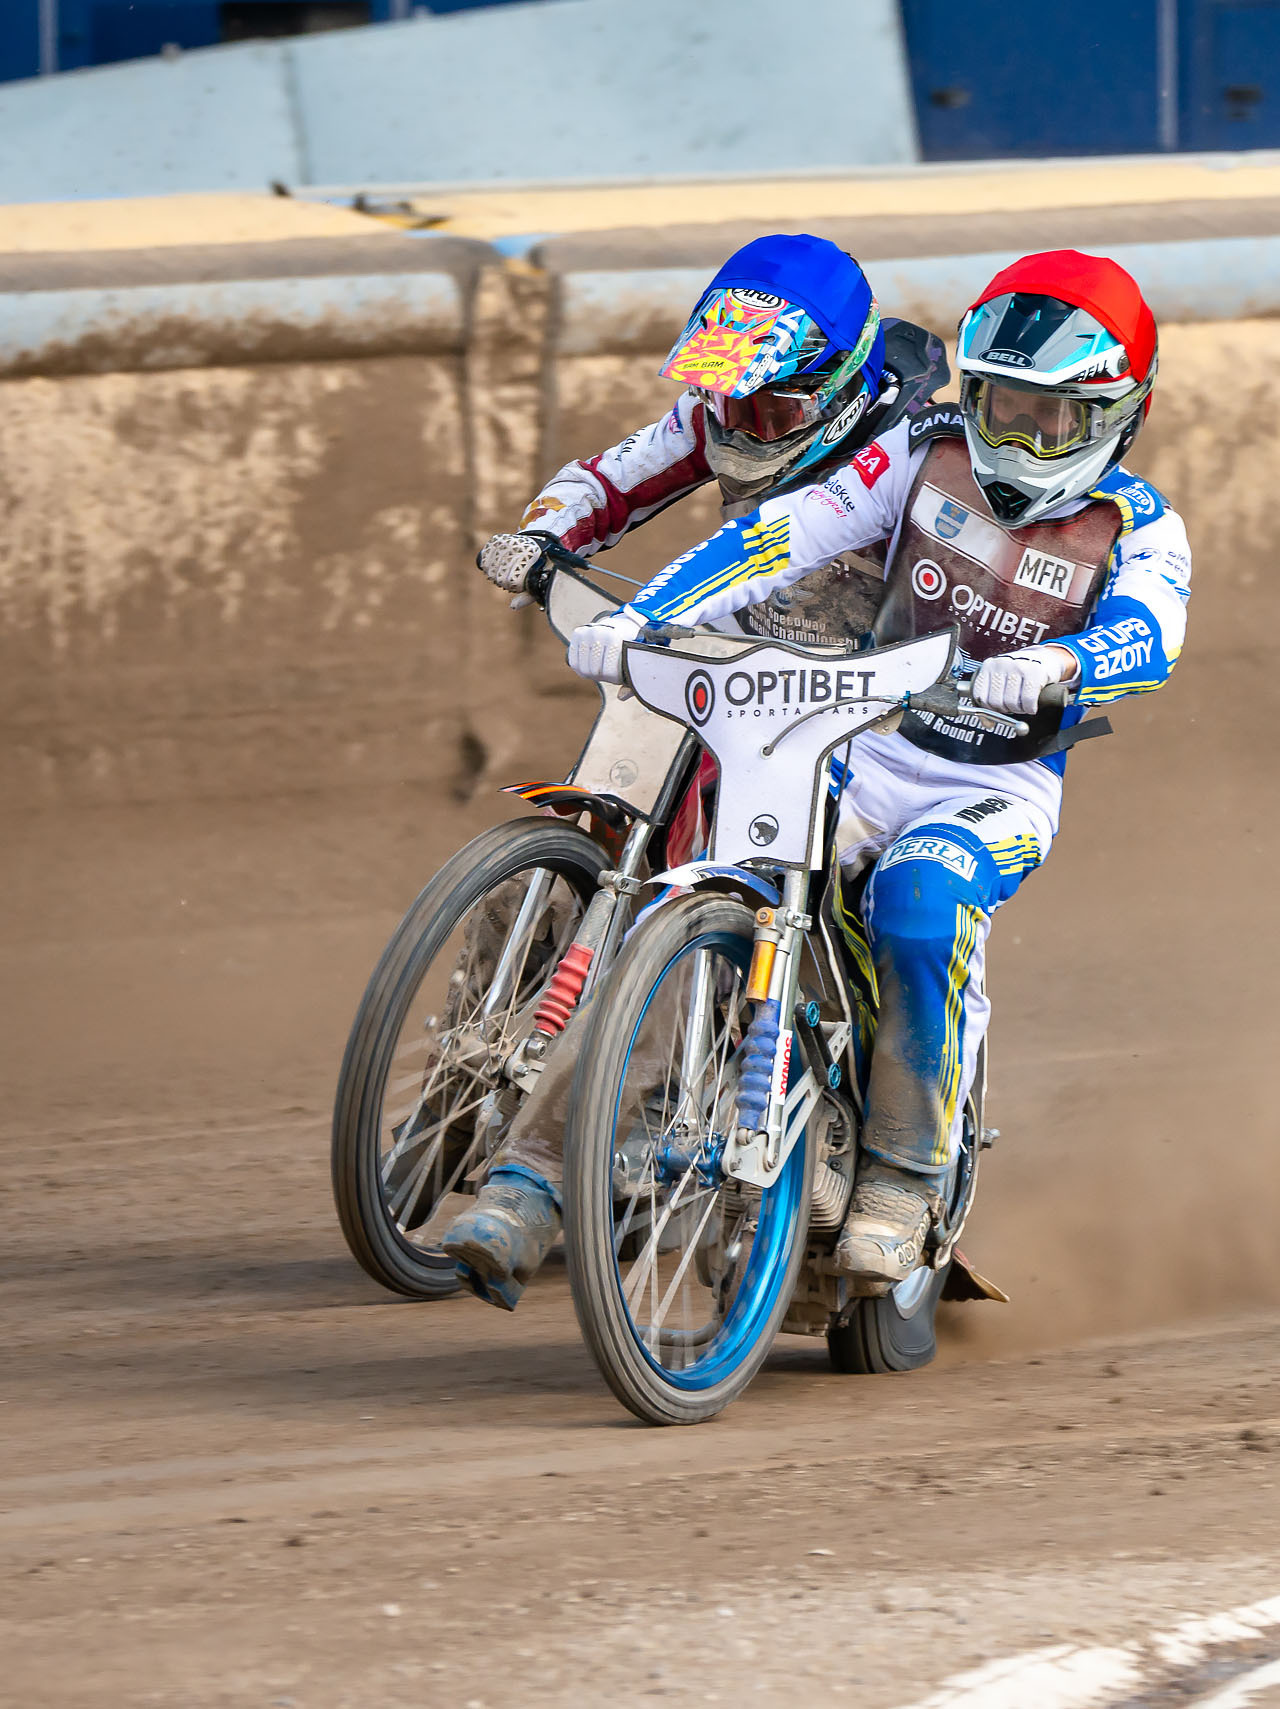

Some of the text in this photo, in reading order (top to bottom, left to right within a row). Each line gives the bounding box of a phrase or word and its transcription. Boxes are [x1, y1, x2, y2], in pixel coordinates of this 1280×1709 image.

[986, 351, 1026, 367] BELL
[910, 413, 964, 436] CANA
[1018, 554, 1068, 593] MFR
[768, 607, 826, 633] Speedway
[948, 605, 1027, 648] SPORTA BAR
[951, 584, 1050, 644] OPTIBET
[772, 624, 858, 650] Championshi
[724, 669, 876, 706] OPTIBET
[727, 707, 868, 718] SPORTA ARS
[932, 720, 975, 743] Round
[976, 733, 985, 746] 1
[888, 840, 966, 869] PERŁA
[779, 1036, 793, 1096] SONAX
